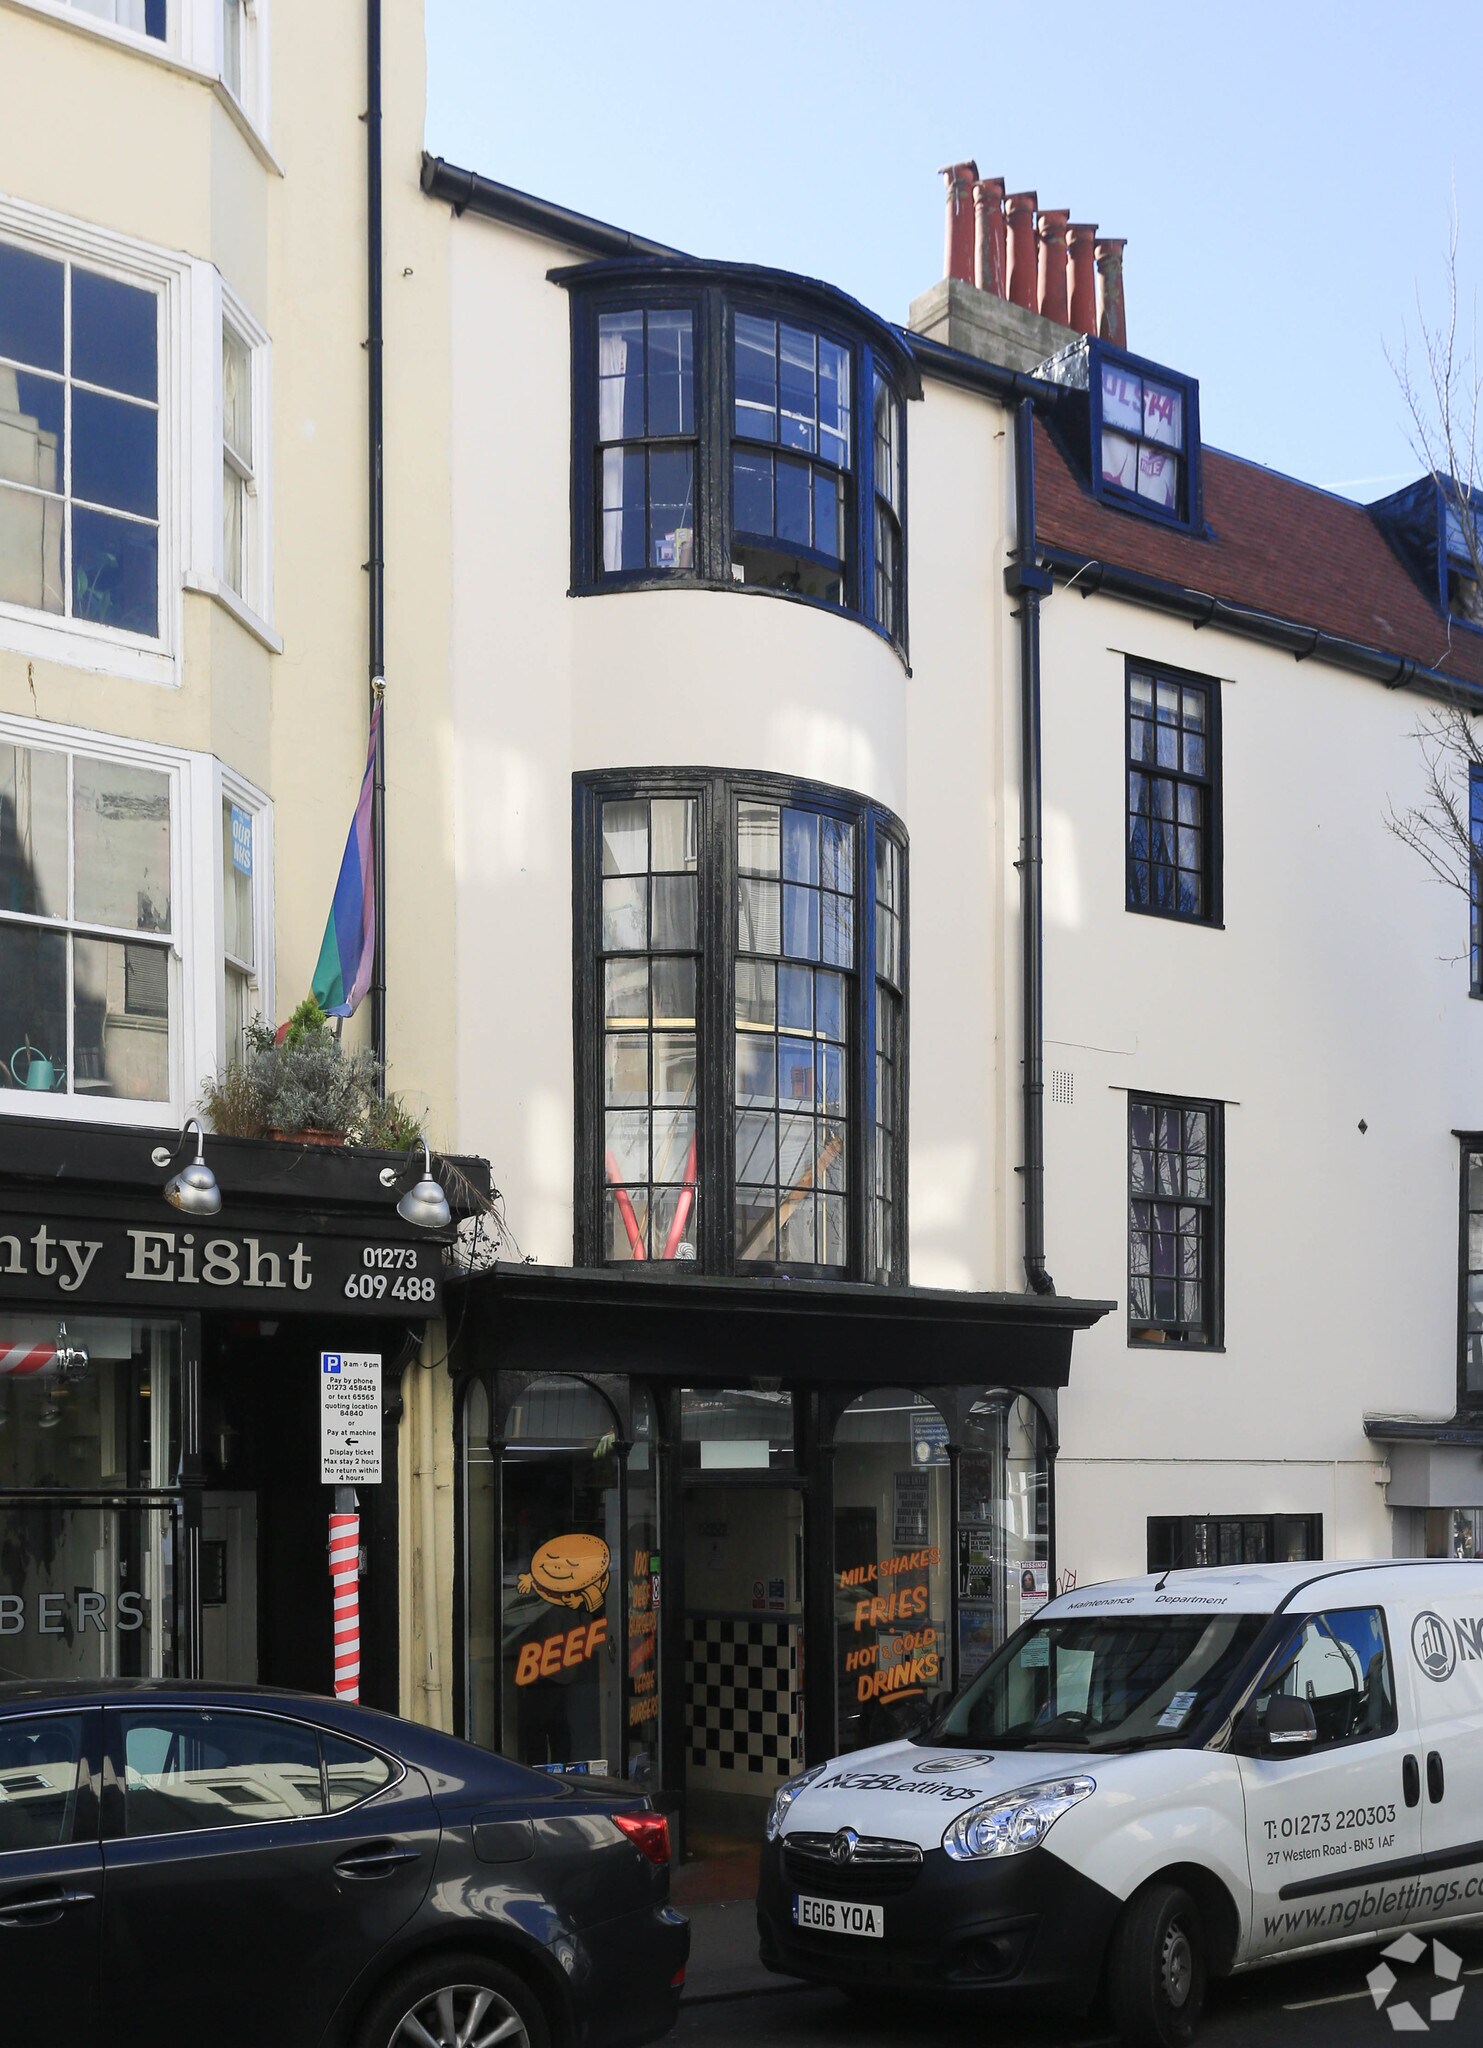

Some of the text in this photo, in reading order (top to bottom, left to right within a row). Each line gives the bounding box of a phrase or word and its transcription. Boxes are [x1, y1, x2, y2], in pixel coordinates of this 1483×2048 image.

[232, 820, 251, 848] OUR
[233, 841, 251, 868] NHS
[125, 1230, 312, 1290] Ei8ht
[363, 1247, 417, 1269] 01273
[344, 1274, 436, 1301] 609 488
[327, 1356, 339, 1372] P
[839, 1547, 941, 1589] MILK SHAKES
[0, 1591, 144, 1635] BERS
[854, 1584, 928, 1632] FRIES
[1067, 1595, 1228, 1610] Maintenance Department
[515, 1617, 608, 1687] BEEF
[845, 1628, 937, 1672] HOT & COLD
[857, 1652, 940, 1702] DRINKS
[1281, 1813, 1330, 1838] 01273
[1336, 1804, 1396, 1830] 220303
[1266, 1852, 1280, 1866] 27
[1282, 1848, 1320, 1862] Western
[1322, 1842, 1346, 1856] Road
[1354, 1838, 1374, 1852] BN3
[803, 1900, 876, 1933] EG16 YOA
